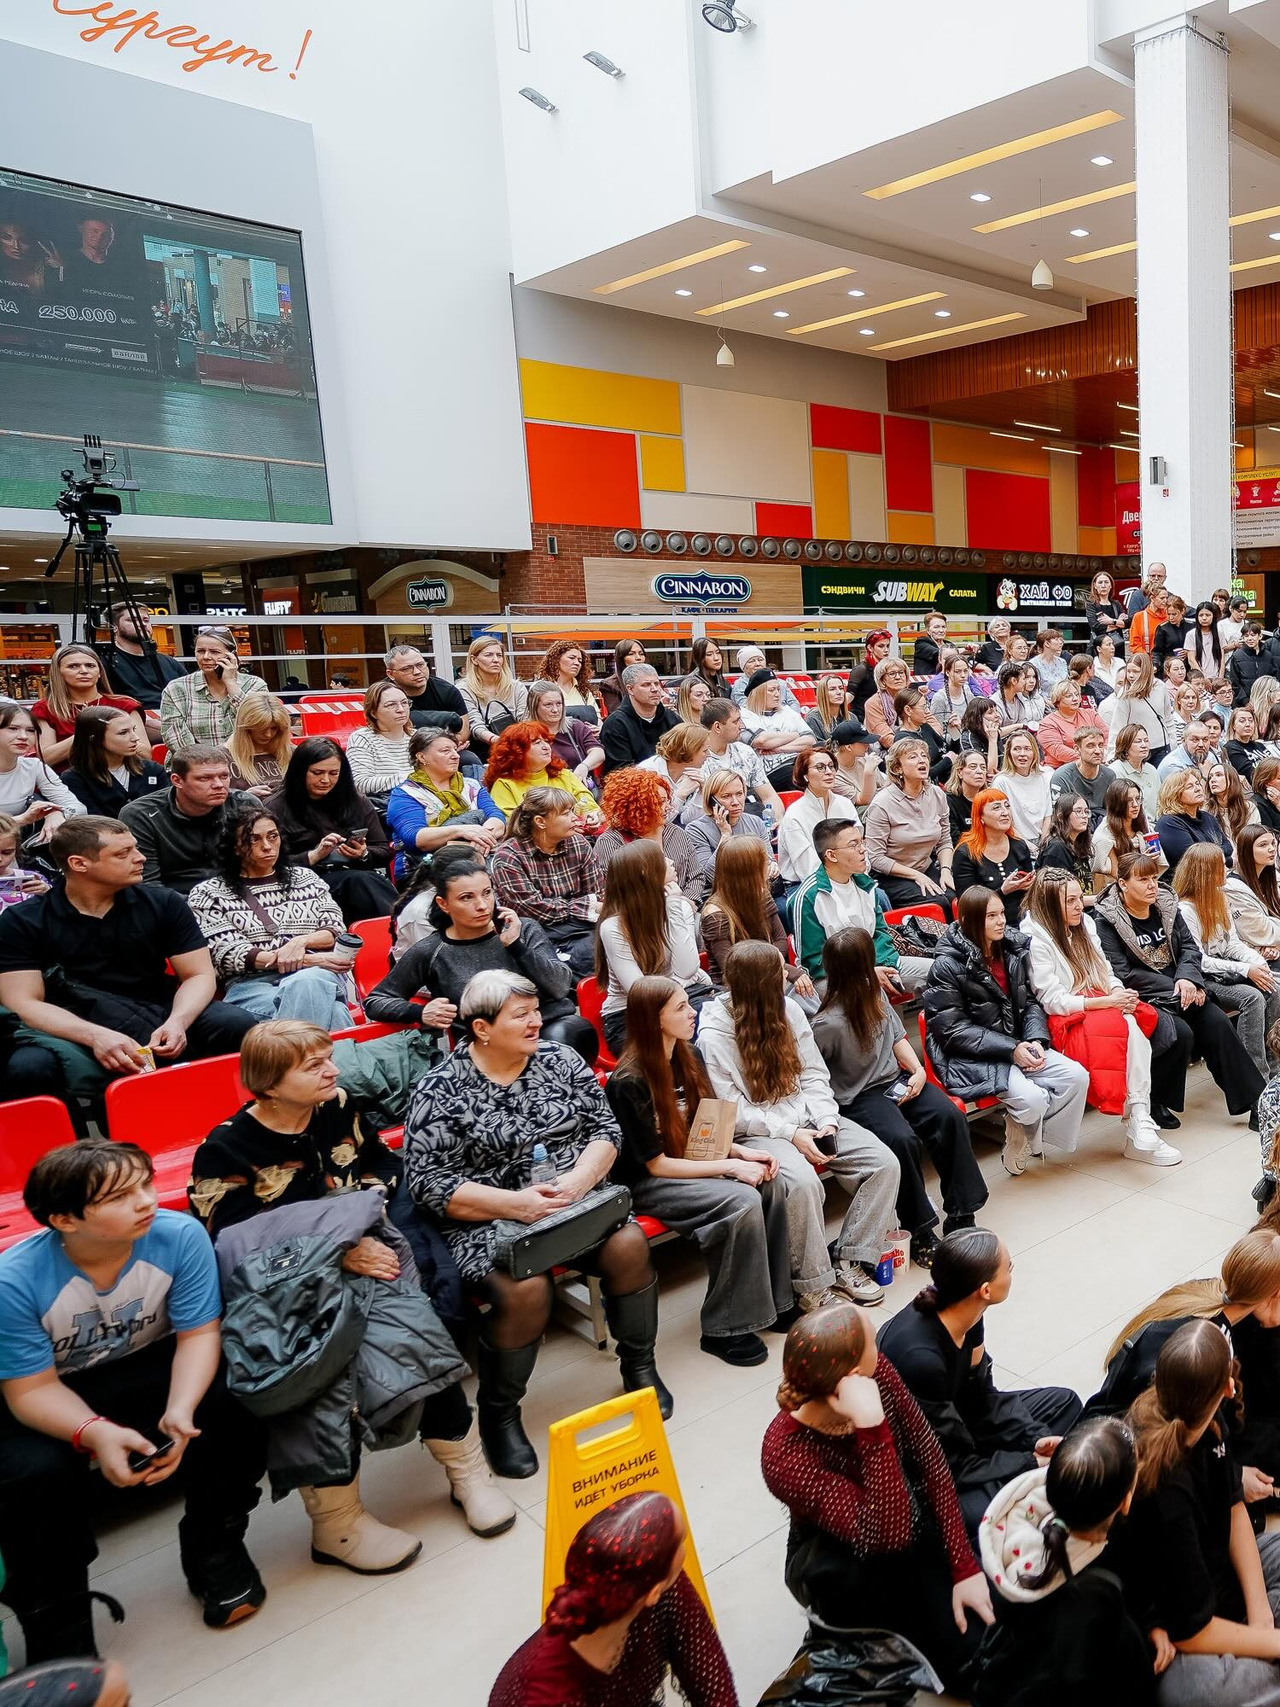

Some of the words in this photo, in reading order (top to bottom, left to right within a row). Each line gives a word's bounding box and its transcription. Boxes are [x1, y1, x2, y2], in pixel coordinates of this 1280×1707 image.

[1122, 510, 1141, 525] Две
[409, 587, 446, 603] CINNABON
[661, 578, 746, 596] CINNABON
[821, 585, 865, 595] СЭНДВИЧИ
[870, 580, 945, 604] SUBWAY
[949, 588, 977, 598] САЛАТЫ
[1019, 582, 1050, 599] ХАЙ
[1052, 585, 1073, 600] ФО
[263, 601, 292, 616] FLUFFY
[572, 1450, 658, 1494] ВНИМАНИЕ
[611, 1466, 660, 1493] УБОРКА
